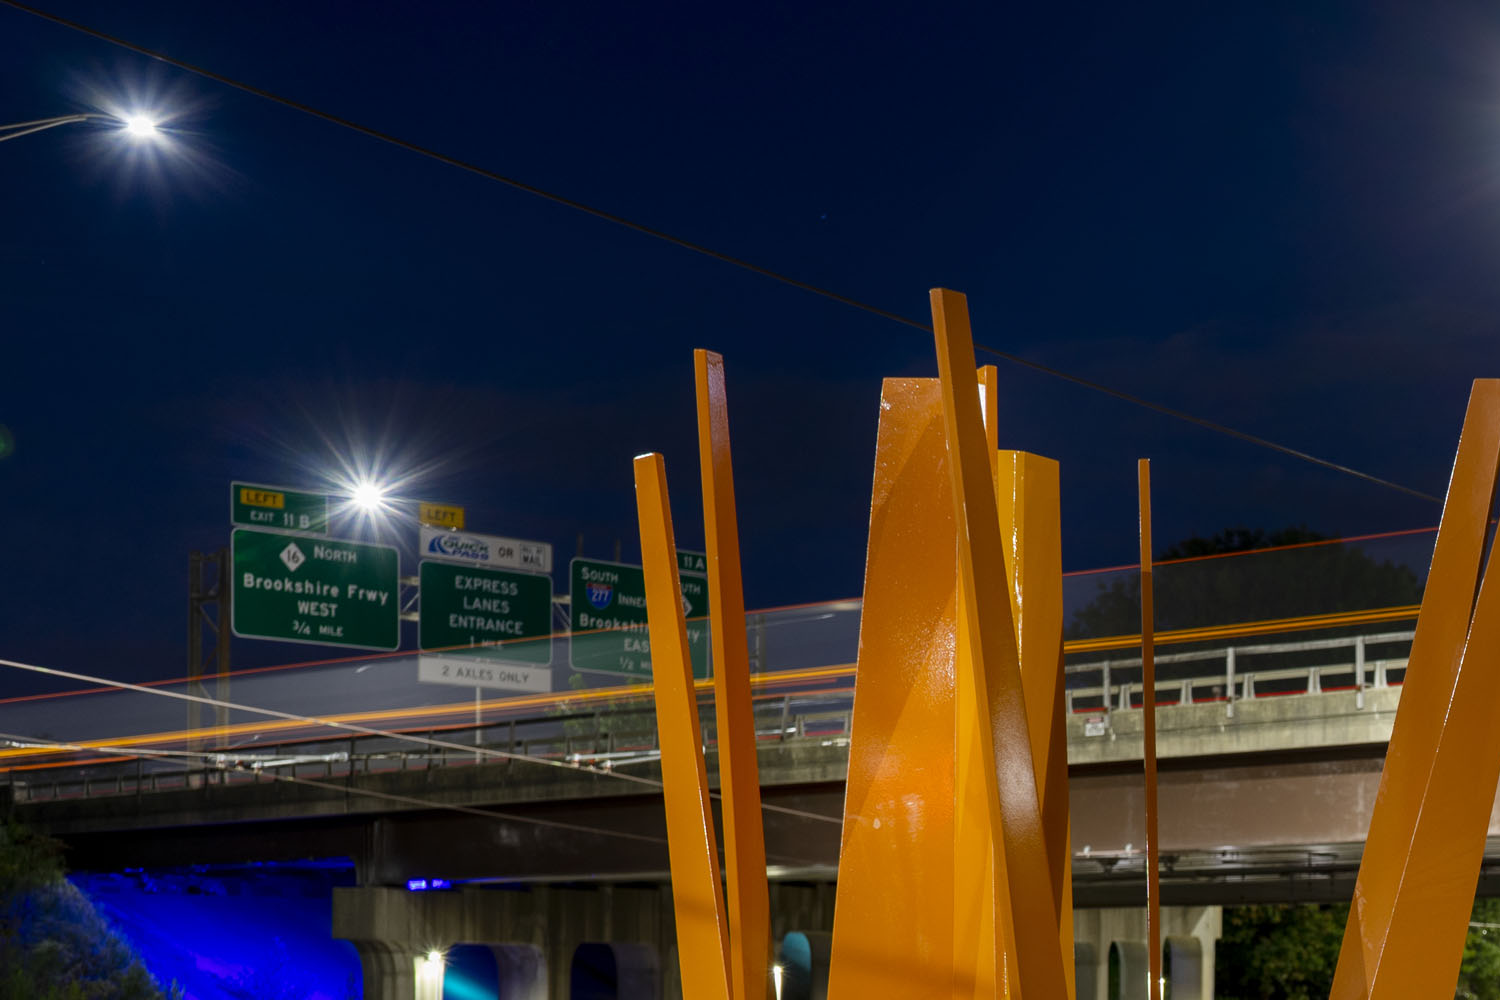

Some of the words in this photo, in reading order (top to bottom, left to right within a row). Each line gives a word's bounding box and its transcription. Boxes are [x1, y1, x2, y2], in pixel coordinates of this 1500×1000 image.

[246, 490, 278, 505] LEFT
[250, 510, 274, 522] EXIT
[284, 512, 295, 528] 11
[300, 514, 310, 529] B
[426, 508, 456, 523] LEFT
[287, 550, 300, 564] 16
[313, 545, 357, 563] NORTH
[443, 539, 489, 553] QUICK
[498, 546, 514, 559] OR
[451, 549, 489, 561] PASS
[683, 556, 693, 568] 11
[696, 558, 705, 569] A
[581, 566, 619, 583] SOUTH
[243, 572, 340, 598] Brookshire
[347, 583, 389, 607] Frwy
[455, 575, 518, 596] EXPRESS
[592, 589, 609, 602] 277
[297, 600, 338, 618] WEST
[463, 596, 510, 614] LANES
[292, 620, 311, 635] 3/4
[319, 625, 343, 637] MILE
[449, 614, 524, 635] ENTRANCE
[579, 612, 648, 635] Brookshir
[623, 638, 650, 653] EAS
[619, 655, 634, 671] 1/2
[442, 665, 450, 677] 2
[456, 665, 494, 681] AXLES
[499, 668, 530, 684] ONLY
